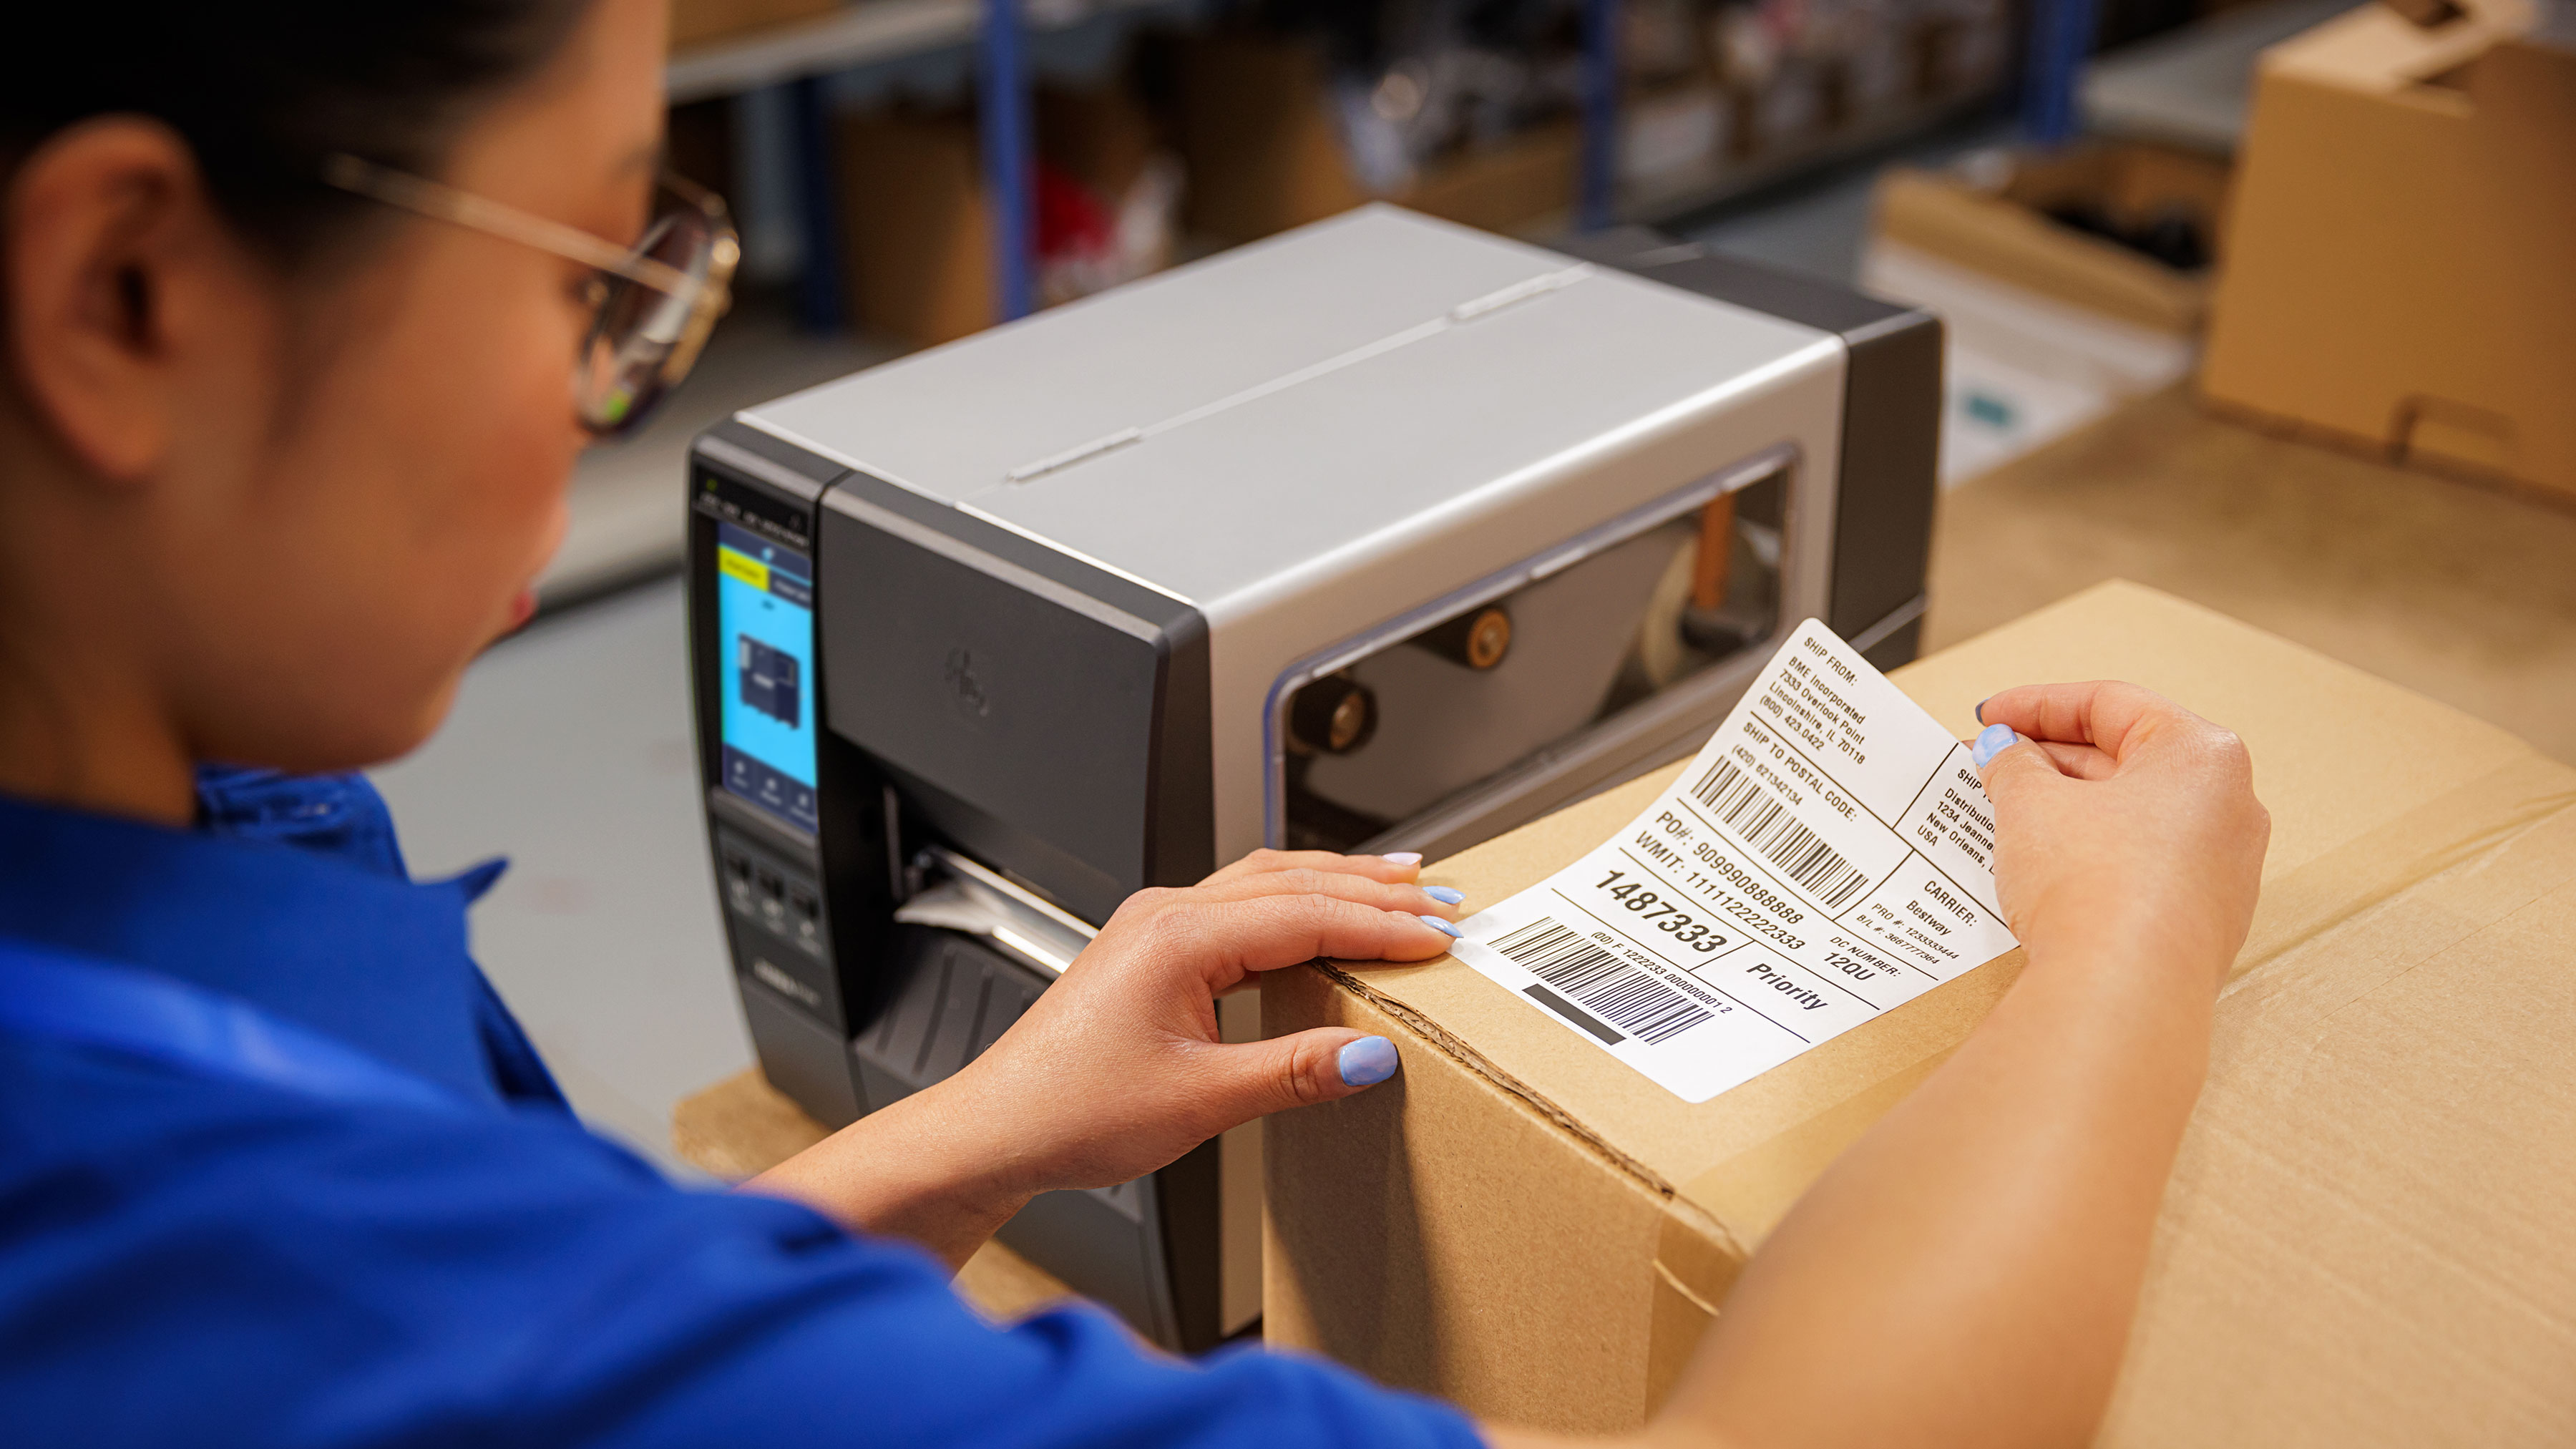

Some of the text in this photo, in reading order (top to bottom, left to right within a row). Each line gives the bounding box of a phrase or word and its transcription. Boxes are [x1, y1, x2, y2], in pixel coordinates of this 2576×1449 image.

[1804, 637, 1858, 686] SHIP FROM:
[1780, 668, 1865, 745] 7333 Overlook Point
[1789, 656, 1865, 724] BME Incorporated
[1760, 694, 1825, 751] (800) 423.0422
[1770, 681, 1865, 764] Lincolnshire, IL 70118
[1732, 744, 1803, 806] (420) 621342134
[1743, 722, 1857, 821] SHIP TO POSTAL CODE:
[1958, 769, 1982, 789] SHIP
[1917, 824, 1938, 847] USA
[1926, 812, 1948, 834] New
[1949, 831, 1985, 868] Orleans,
[1937, 801, 1995, 853] 1234 Jeanne
[1636, 831, 1805, 950] WMIT: 1111122222333
[1656, 811, 1804, 924] PO#: 909990888888
[1596, 870, 1727, 952] 1487333
[1872, 903, 1894, 920] PRO
[1906, 927, 1960, 959] 1233333444
[1906, 900, 1952, 936] Bestway
[1924, 880, 1977, 927] CARRIER:
[1824, 952, 1875, 981] 12QU
[1830, 936, 1901, 977] DC NUMBER:
[1856, 914, 1875, 928] B/L
[1885, 933, 1940, 964] 3667777364
[1591, 932, 1614, 945] (00)
[1623, 948, 1667, 975] 1222233
[1664, 973, 1723, 1008] 000000001
[1746, 963, 1828, 1010] Priority
